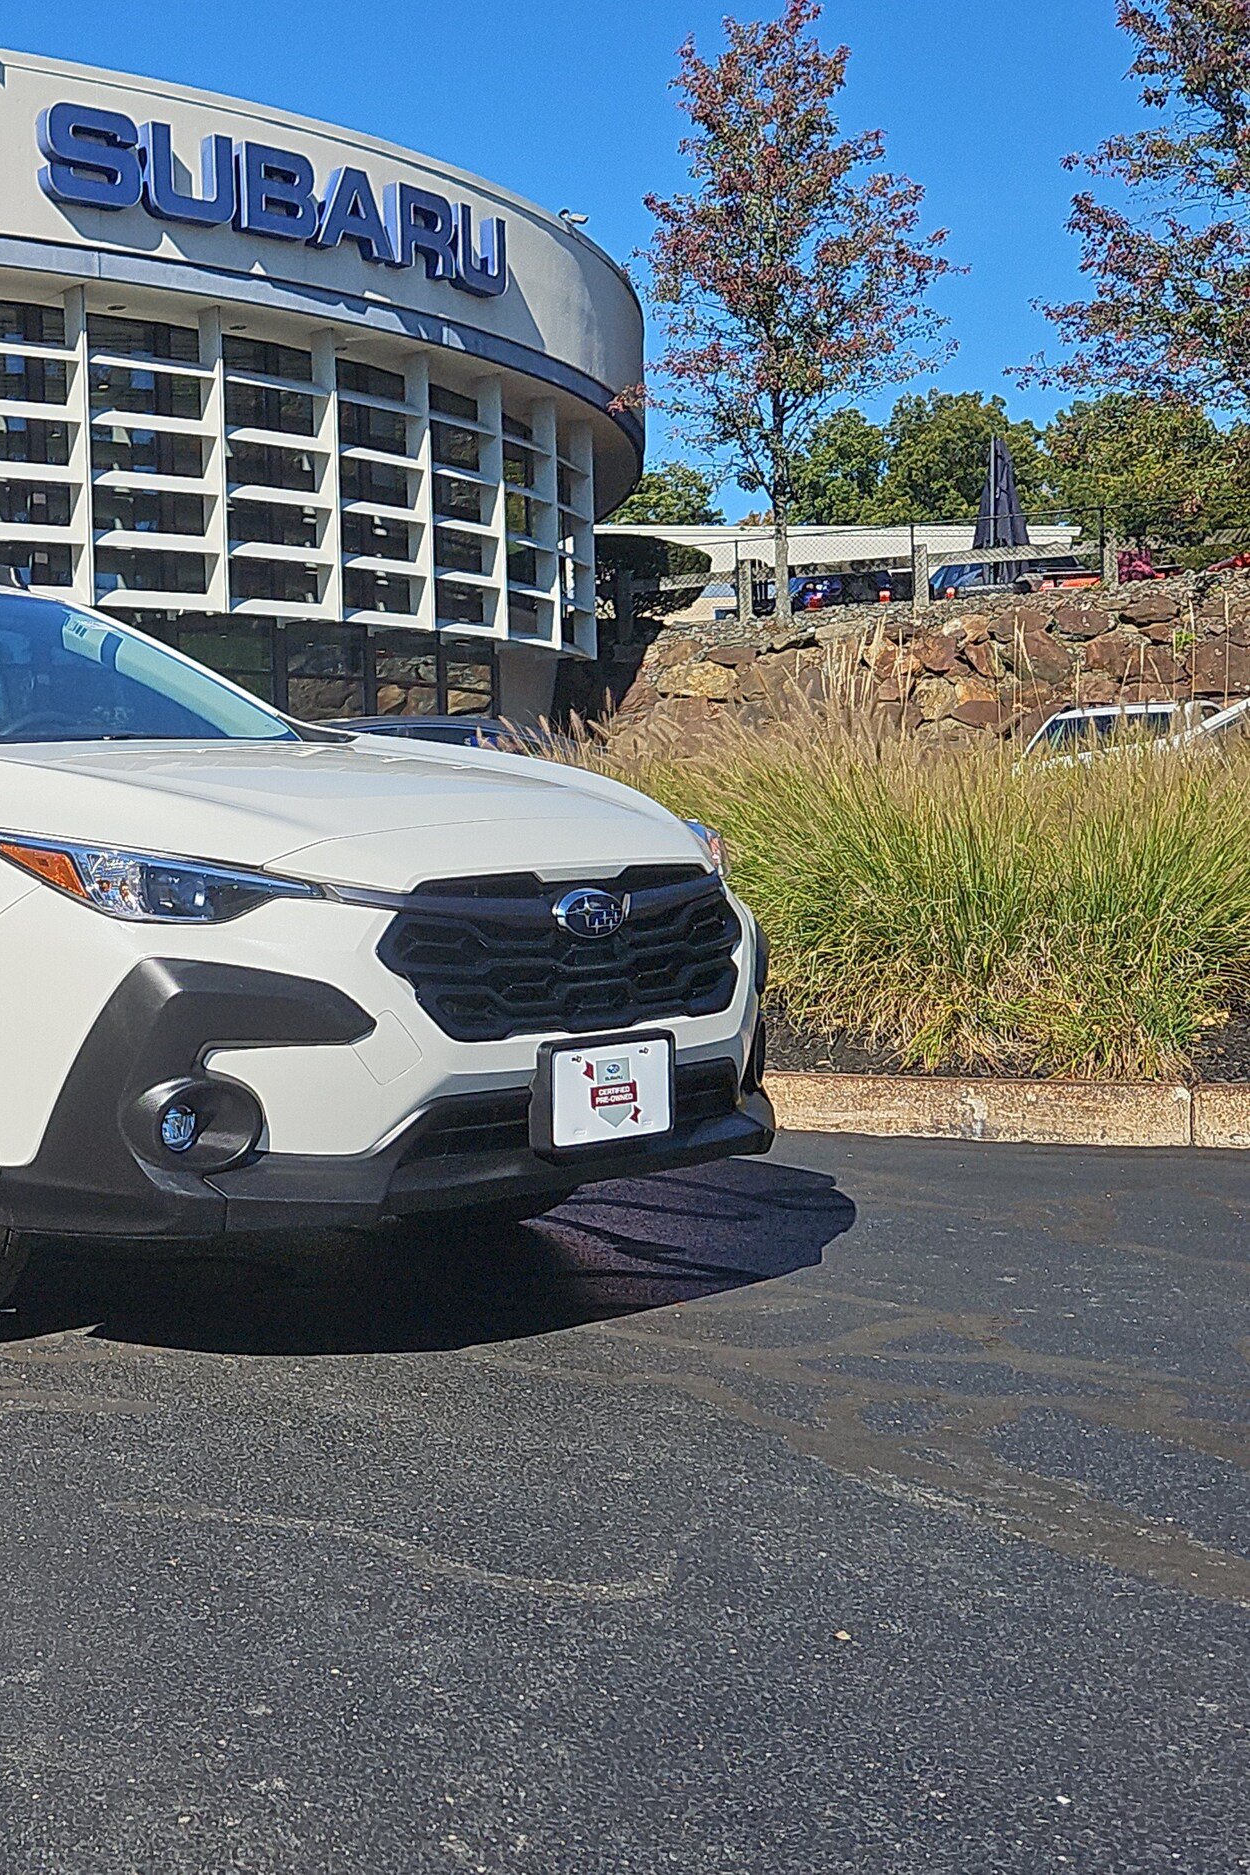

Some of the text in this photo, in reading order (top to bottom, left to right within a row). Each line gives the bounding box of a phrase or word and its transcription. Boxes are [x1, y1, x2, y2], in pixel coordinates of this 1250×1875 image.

[37, 102, 508, 298] SUBARU
[599, 1086, 630, 1096] CERTIFIED
[595, 1093, 633, 1105] PRE-OWNED
